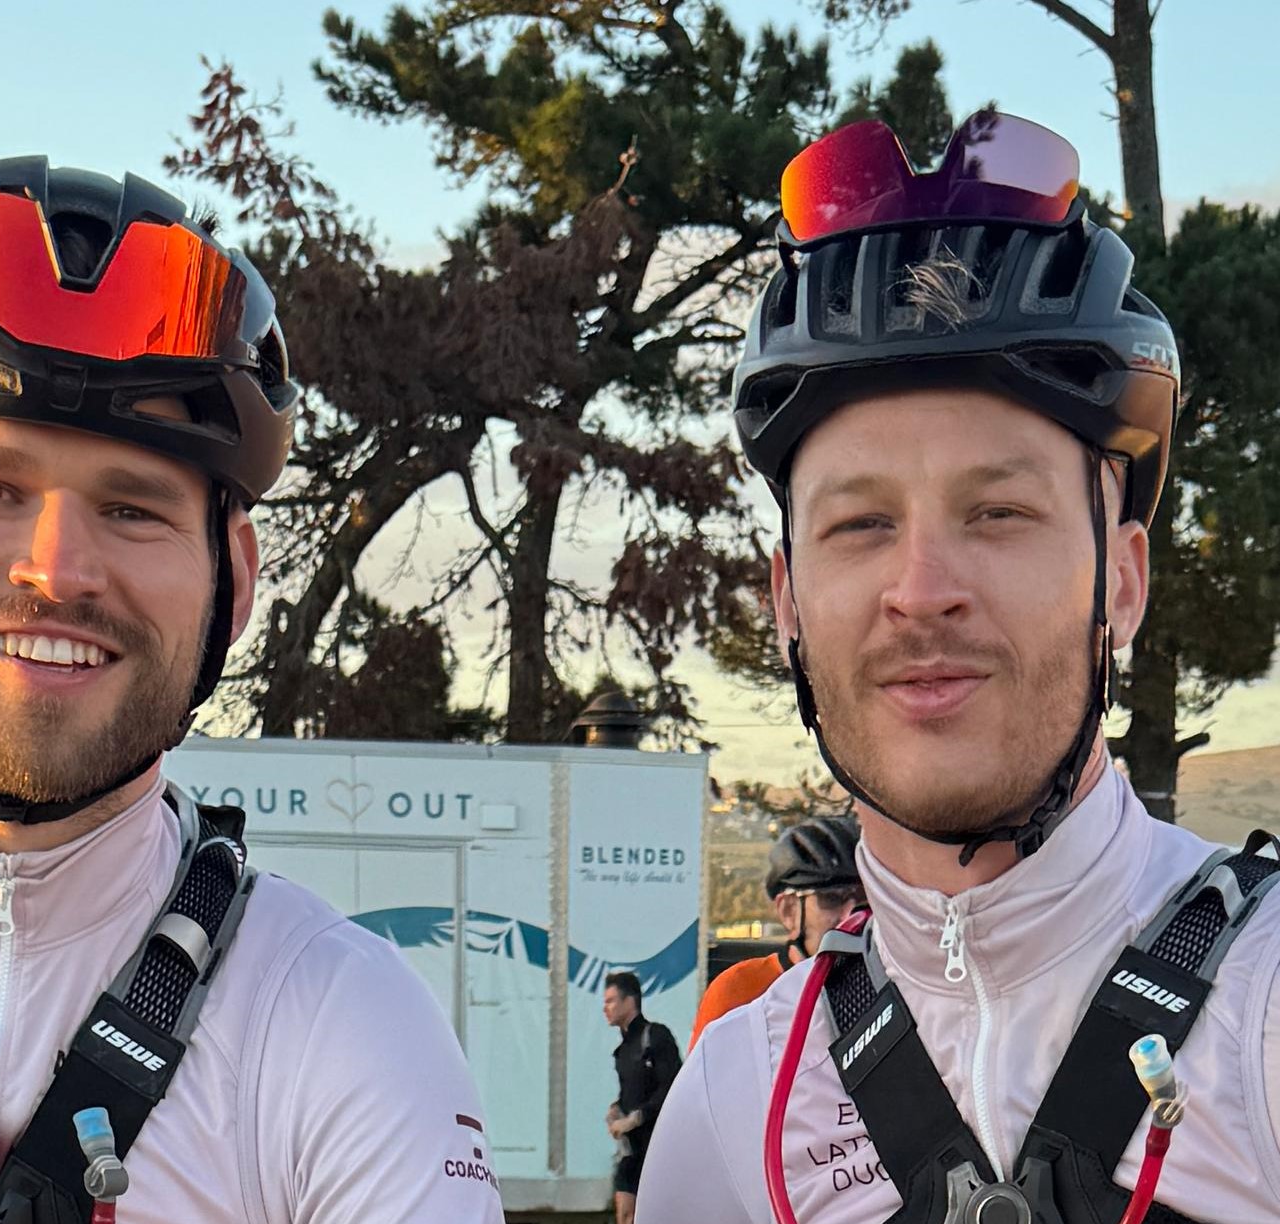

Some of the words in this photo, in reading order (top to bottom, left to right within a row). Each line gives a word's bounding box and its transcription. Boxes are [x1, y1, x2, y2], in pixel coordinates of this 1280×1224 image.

[190, 785, 309, 816] YOUR
[388, 791, 474, 820] OUT
[581, 846, 686, 866] BLENDED
[1112, 969, 1191, 1013] USWE
[91, 1019, 167, 1072] USWE
[842, 1003, 893, 1071] USWE
[838, 1102, 863, 1126] E
